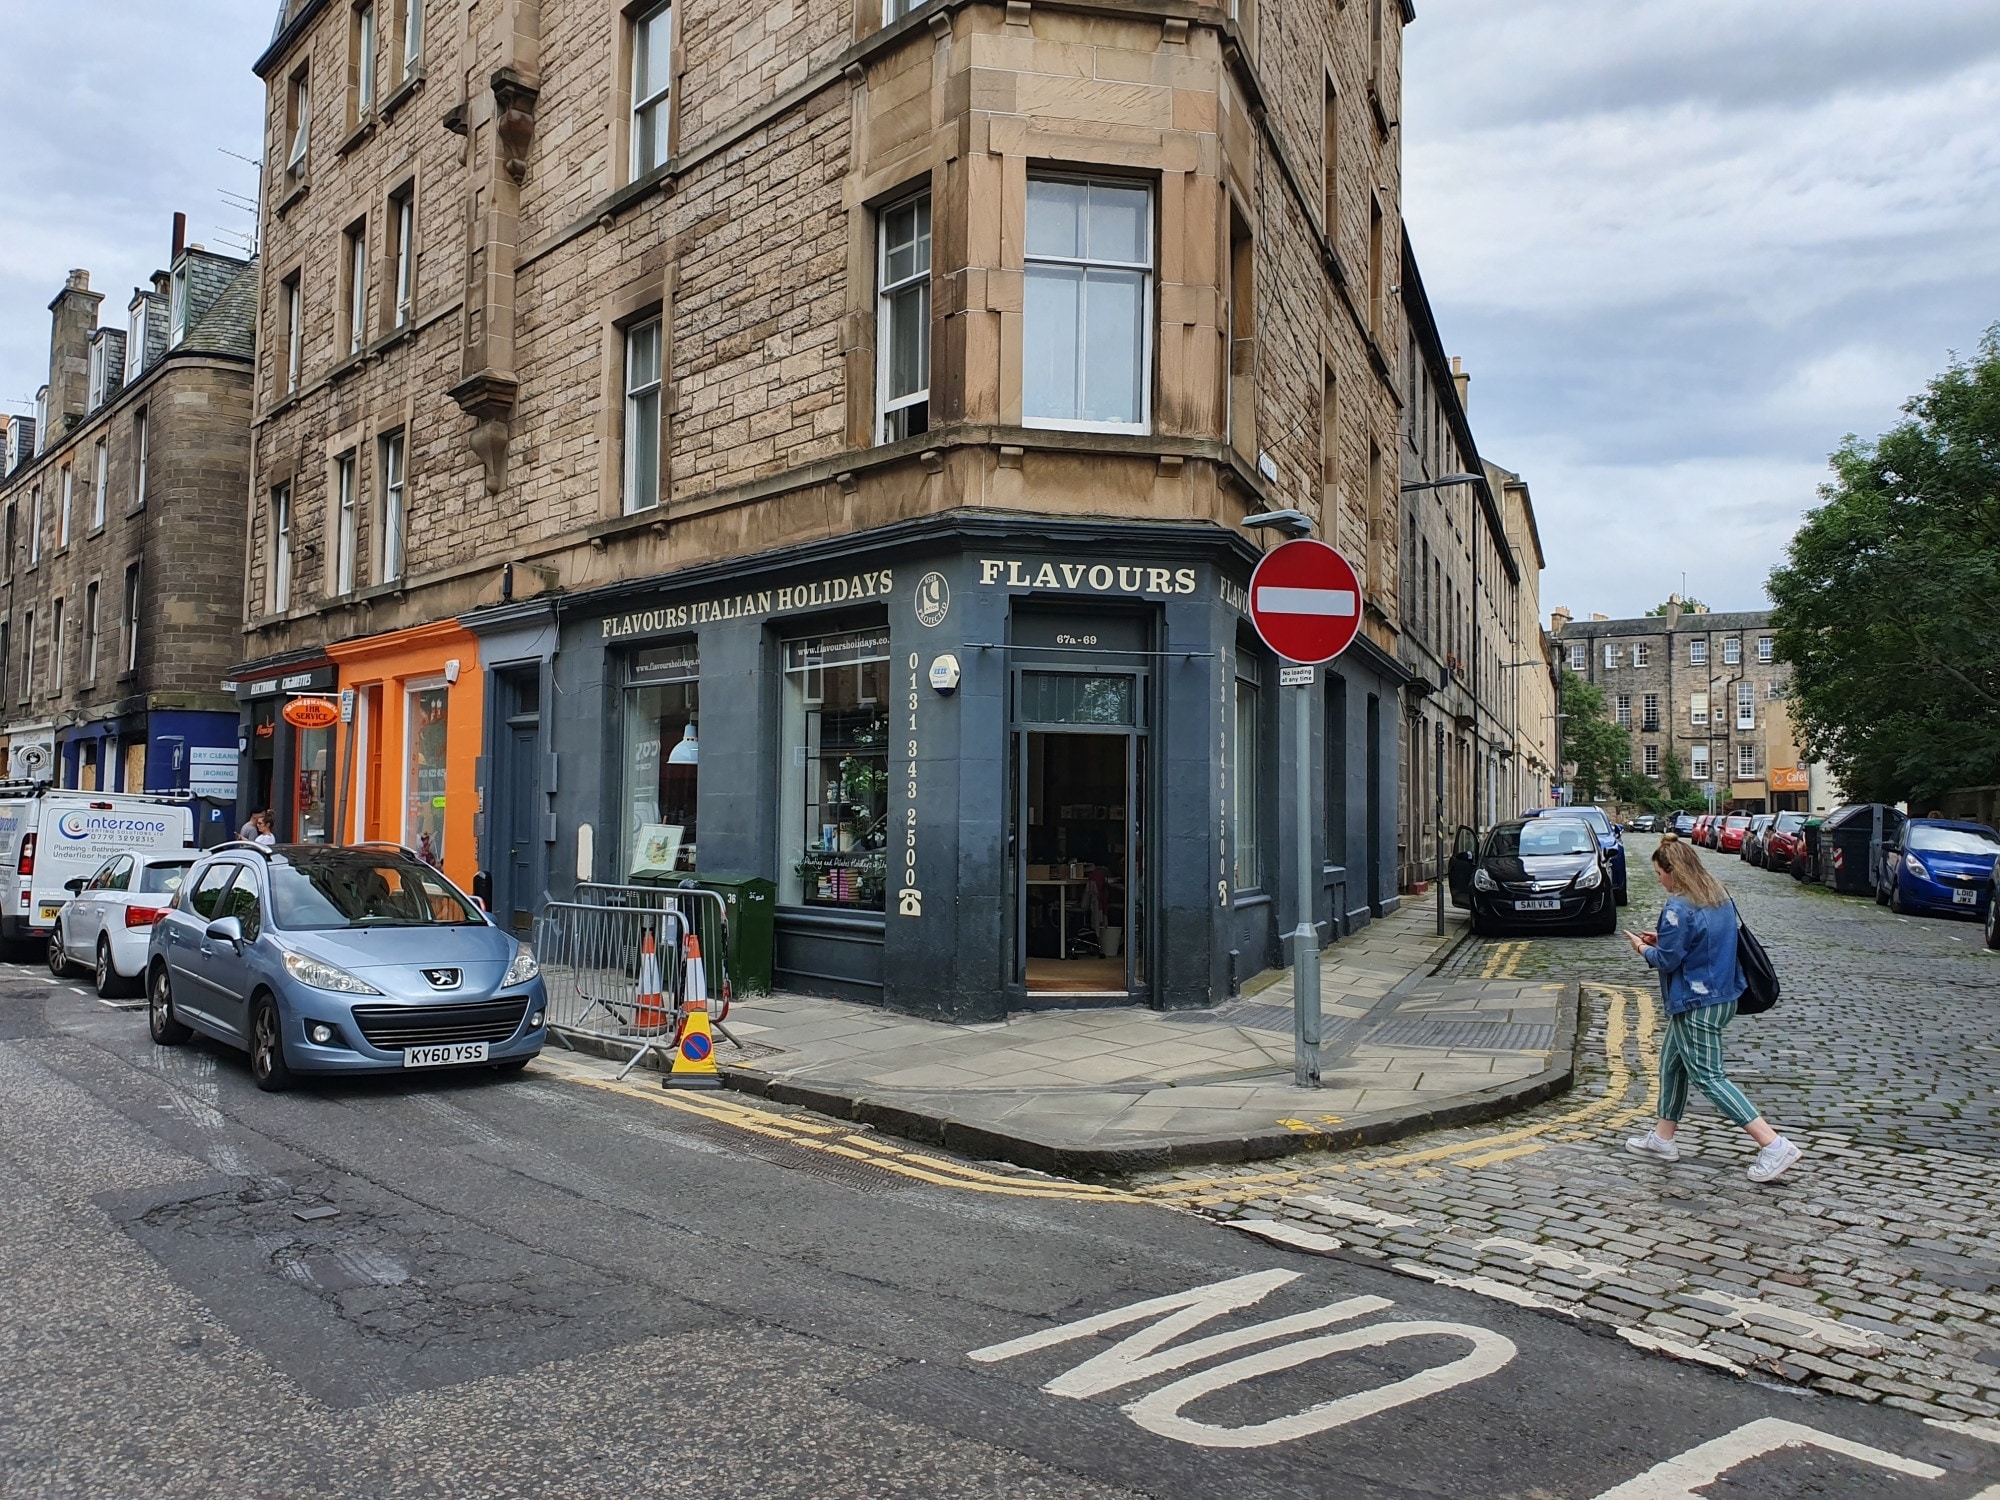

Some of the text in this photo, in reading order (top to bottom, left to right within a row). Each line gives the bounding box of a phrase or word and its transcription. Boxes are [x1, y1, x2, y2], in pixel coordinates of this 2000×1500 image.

[979, 559, 1196, 594] FLAVOURS
[601, 569, 894, 638] FLAVOURS ITALIAN HOLIDAYS
[1220, 575, 1251, 616] FLAVO
[917, 601, 947, 625] PROTECTED
[905, 652, 919, 886] 0131 343 2500
[86, 816, 166, 832] interzone
[90, 833, 114, 841] 0779
[53, 844, 87, 853] Plumbing
[91, 845, 125, 853] Bathroom
[53, 851, 95, 859] Underfloor
[727, 893, 736, 904] 36
[1537, 900, 1554, 909] VLR
[411, 1045, 483, 1064] KY60 YSS
[967, 1267, 1519, 1449] NO
